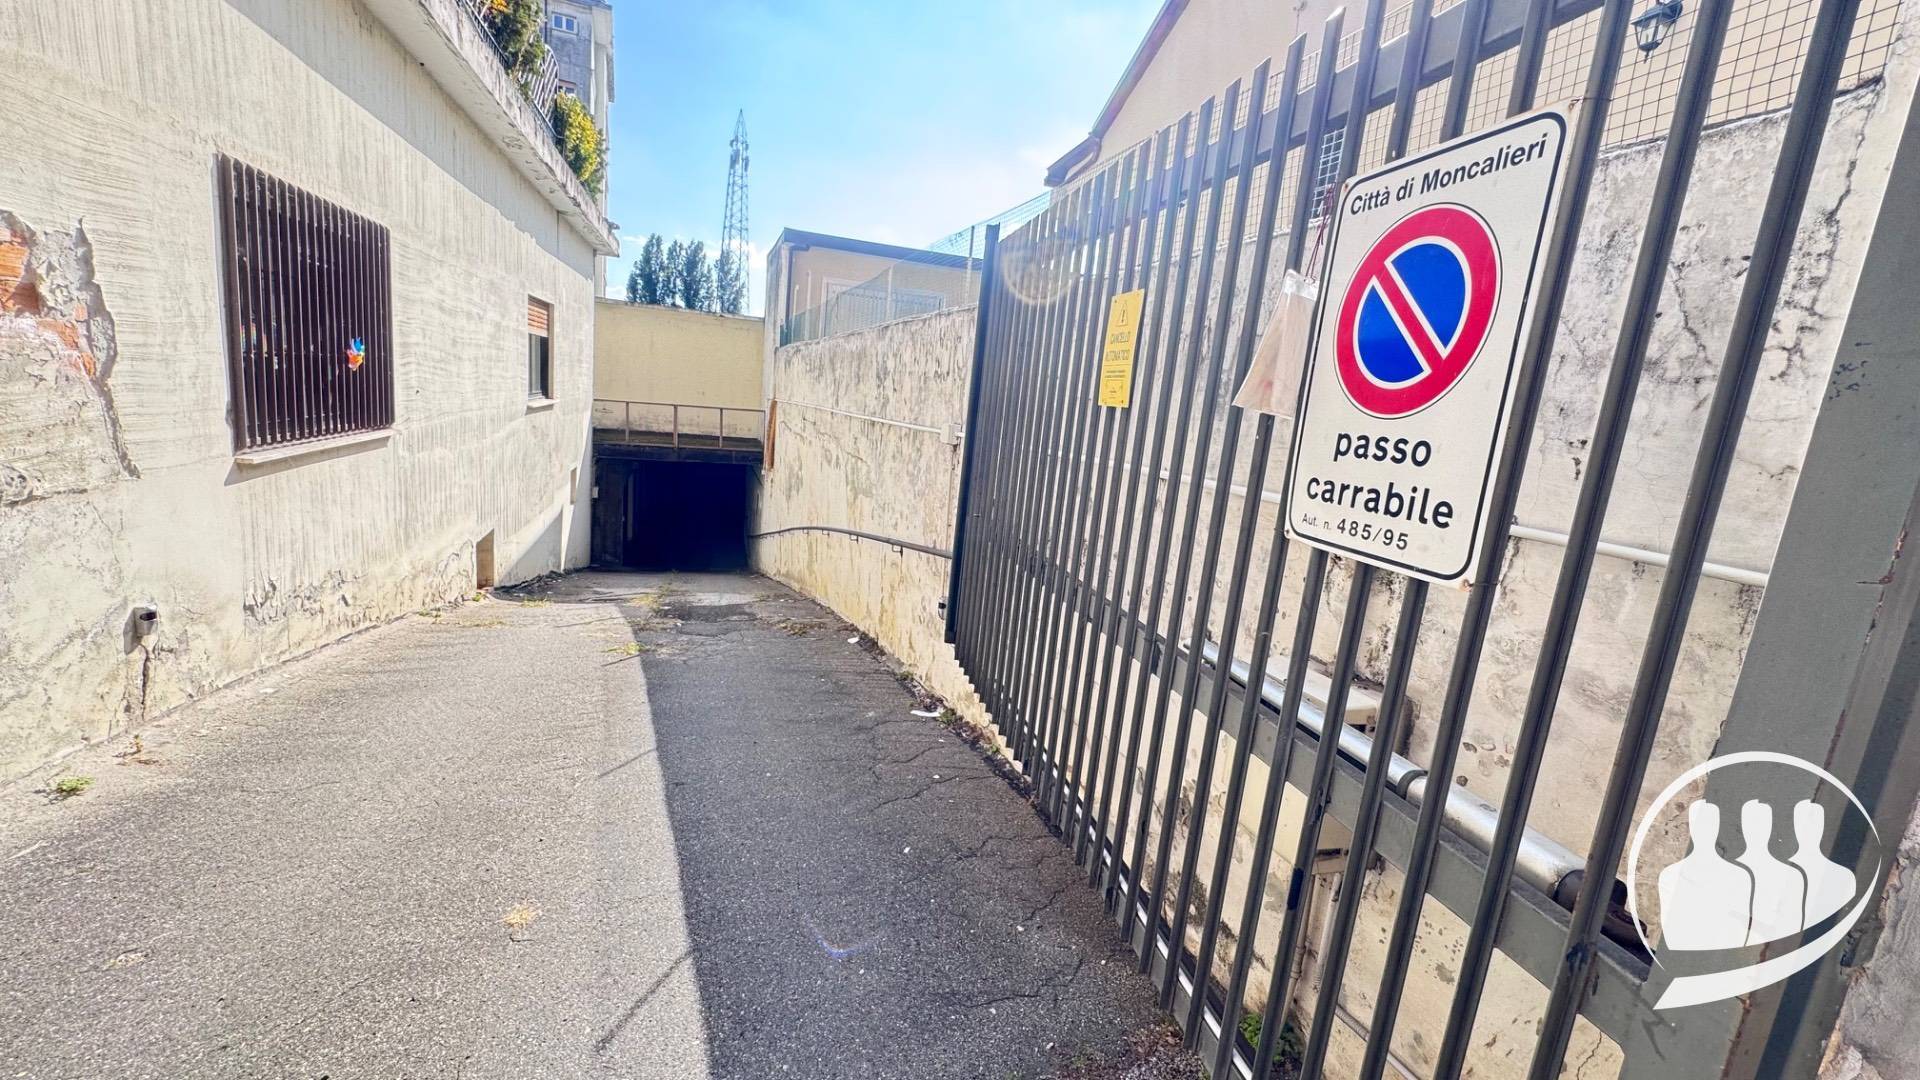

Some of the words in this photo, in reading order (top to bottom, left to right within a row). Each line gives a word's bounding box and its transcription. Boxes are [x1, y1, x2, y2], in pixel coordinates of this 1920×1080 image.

[1351, 185, 1390, 215] Città
[1396, 176, 1417, 203] di
[1420, 133, 1547, 194] Moncalieri
[1333, 430, 1432, 467] passo
[1307, 477, 1454, 530] carrabile
[1301, 513, 1319, 529] Aut.
[1336, 517, 1409, 551] 485/95
